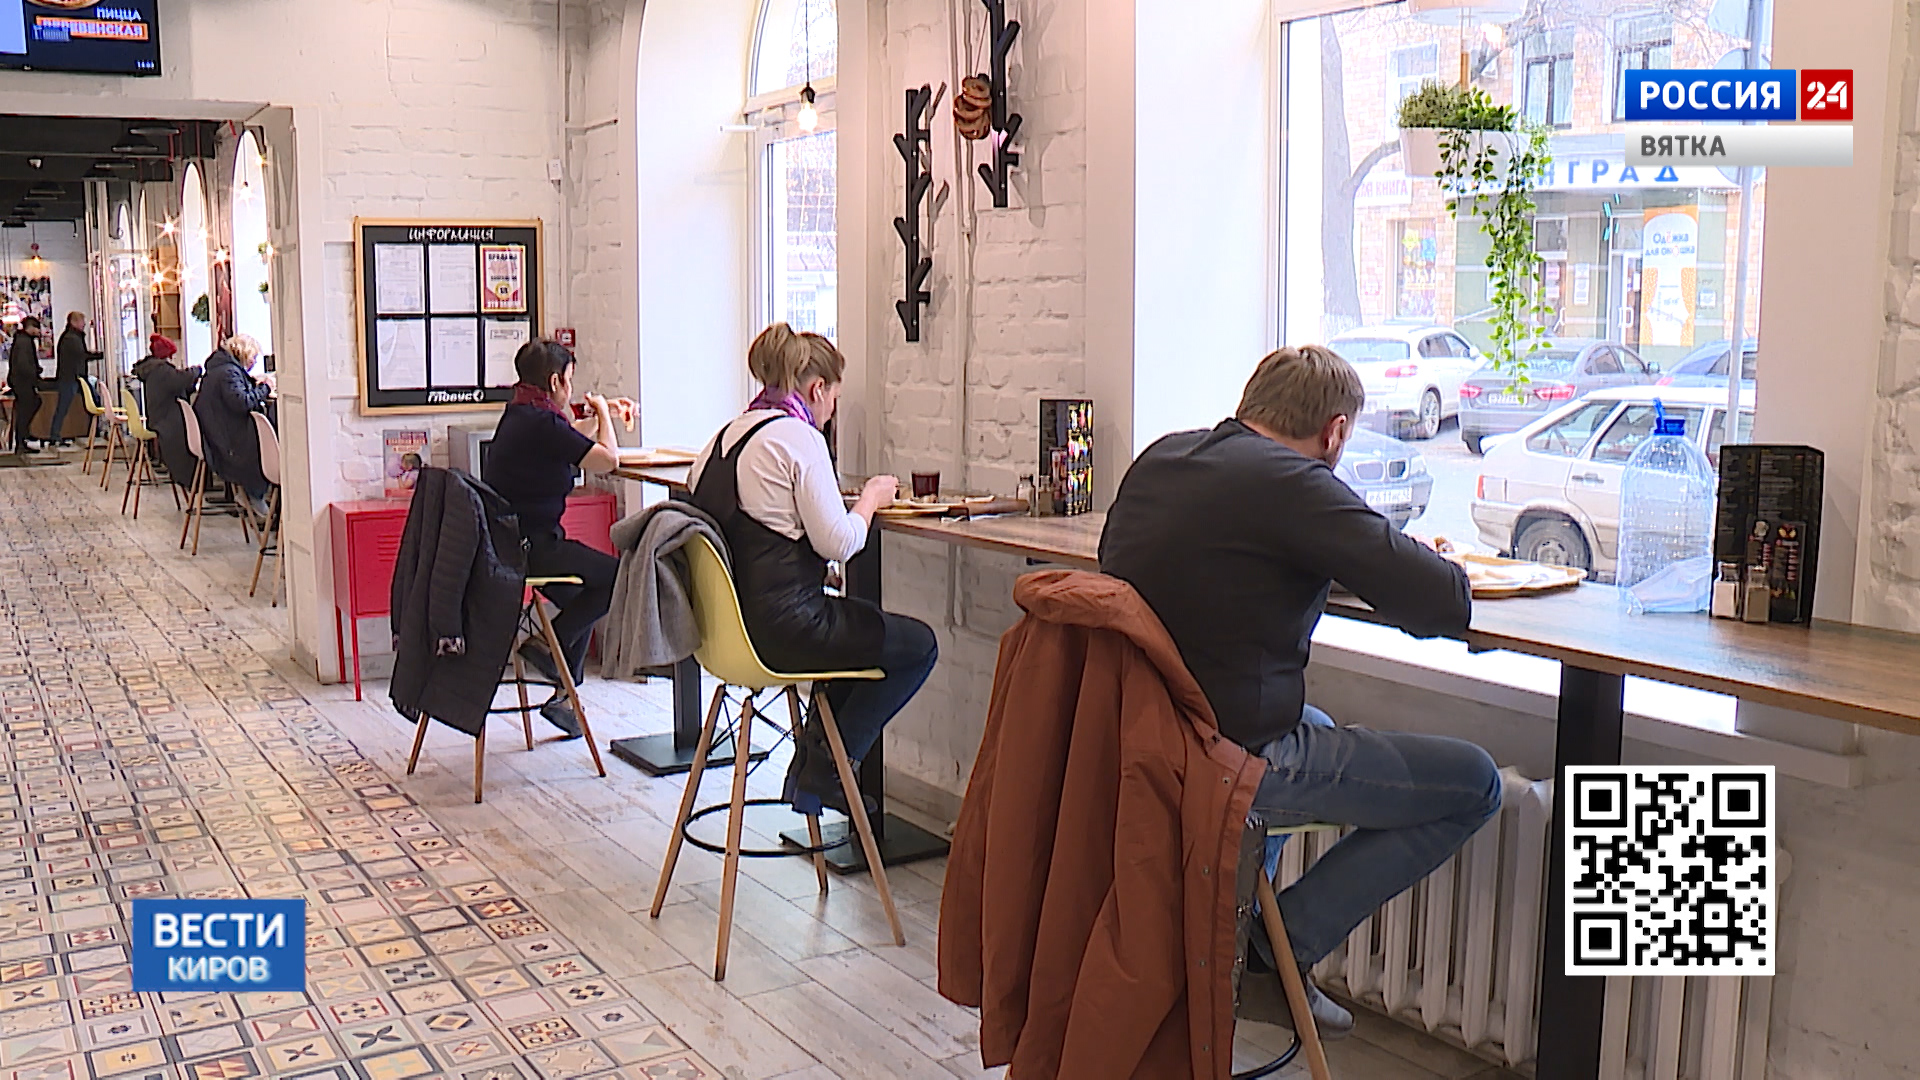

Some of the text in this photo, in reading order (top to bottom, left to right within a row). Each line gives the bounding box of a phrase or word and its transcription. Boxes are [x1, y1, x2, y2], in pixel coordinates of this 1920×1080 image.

[96, 7, 141, 21] ПИЦЦА
[1376, 179, 1409, 197] КНИГА
[408, 227, 494, 241] ИНФОРМАЦИЯ
